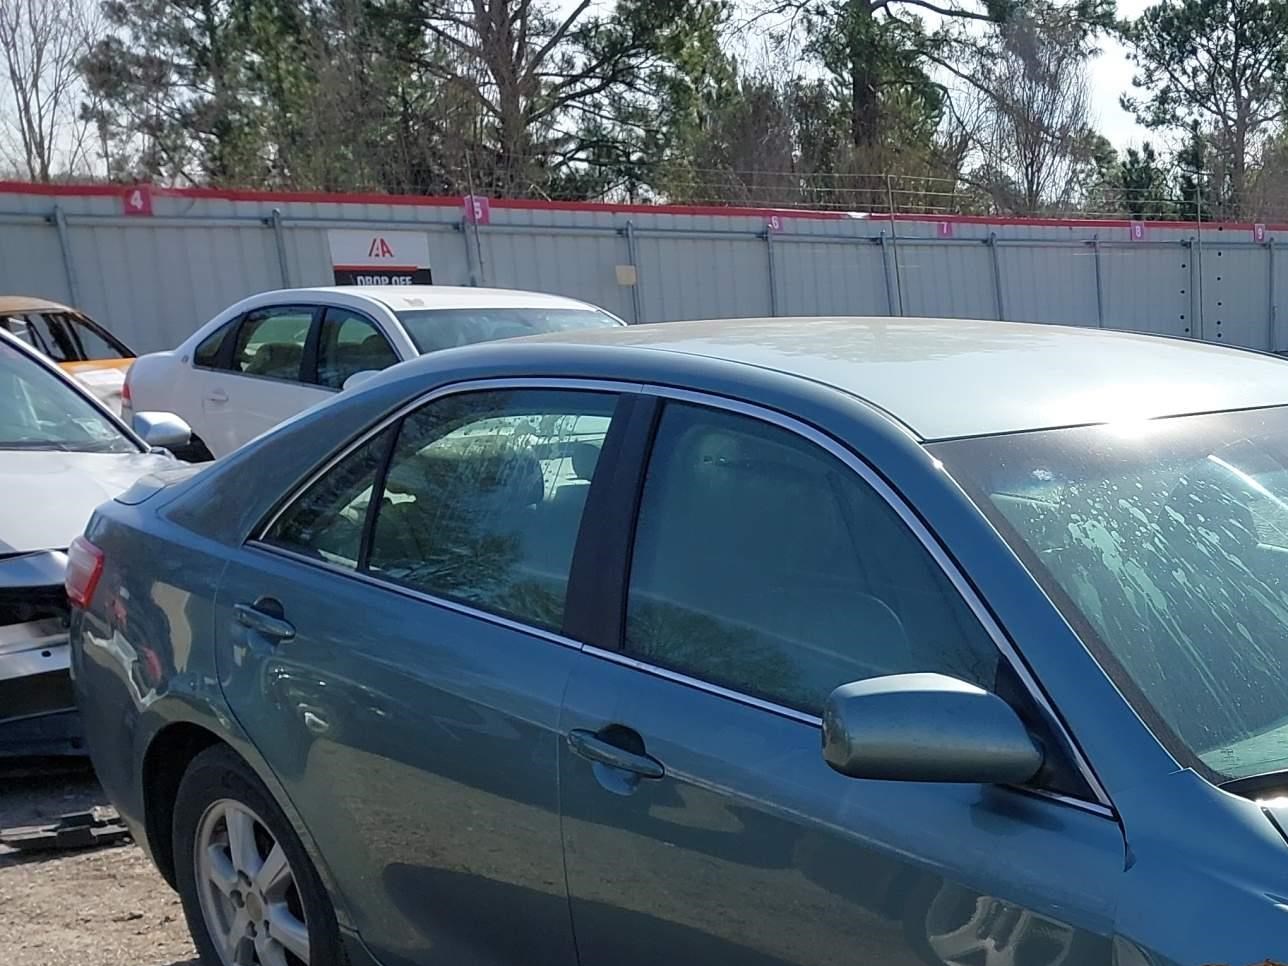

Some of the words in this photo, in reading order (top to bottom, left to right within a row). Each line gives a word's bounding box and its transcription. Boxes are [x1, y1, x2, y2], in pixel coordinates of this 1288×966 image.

[130, 190, 143, 210] 4
[474, 201, 483, 219] 5
[772, 216, 780, 230] 6
[942, 221, 949, 234] 7
[1135, 225, 1142, 238] 8
[1257, 229, 1263, 240] 9
